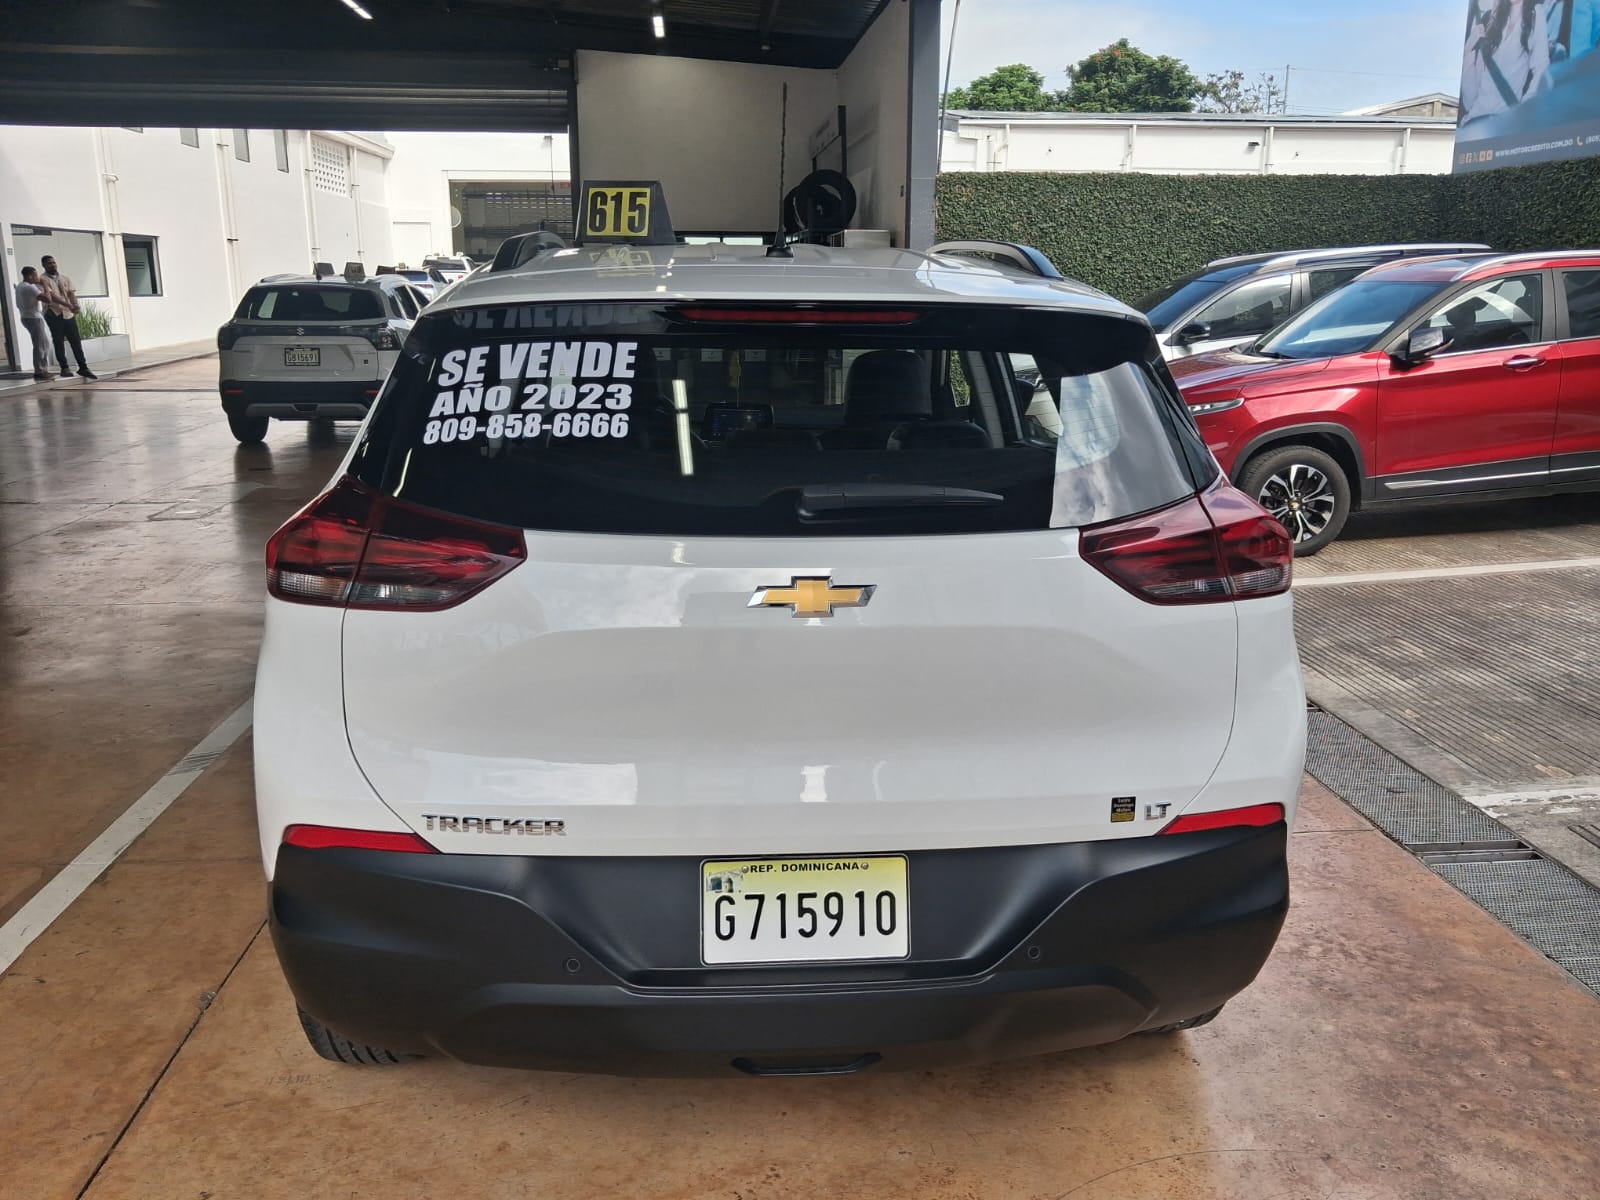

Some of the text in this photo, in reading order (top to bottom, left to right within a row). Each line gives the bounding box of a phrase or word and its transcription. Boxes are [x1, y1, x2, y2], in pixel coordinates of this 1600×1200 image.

[589, 191, 647, 233] 615
[438, 342, 638, 386] SE VENDE
[428, 381, 632, 418] AÑO 2023
[423, 413, 629, 445] 809-858-6666
[421, 814, 567, 836] TRACKER
[1144, 801, 1171, 820] LT
[750, 862, 860, 873] REP. DOMINICANA
[715, 890, 896, 940] G715910
